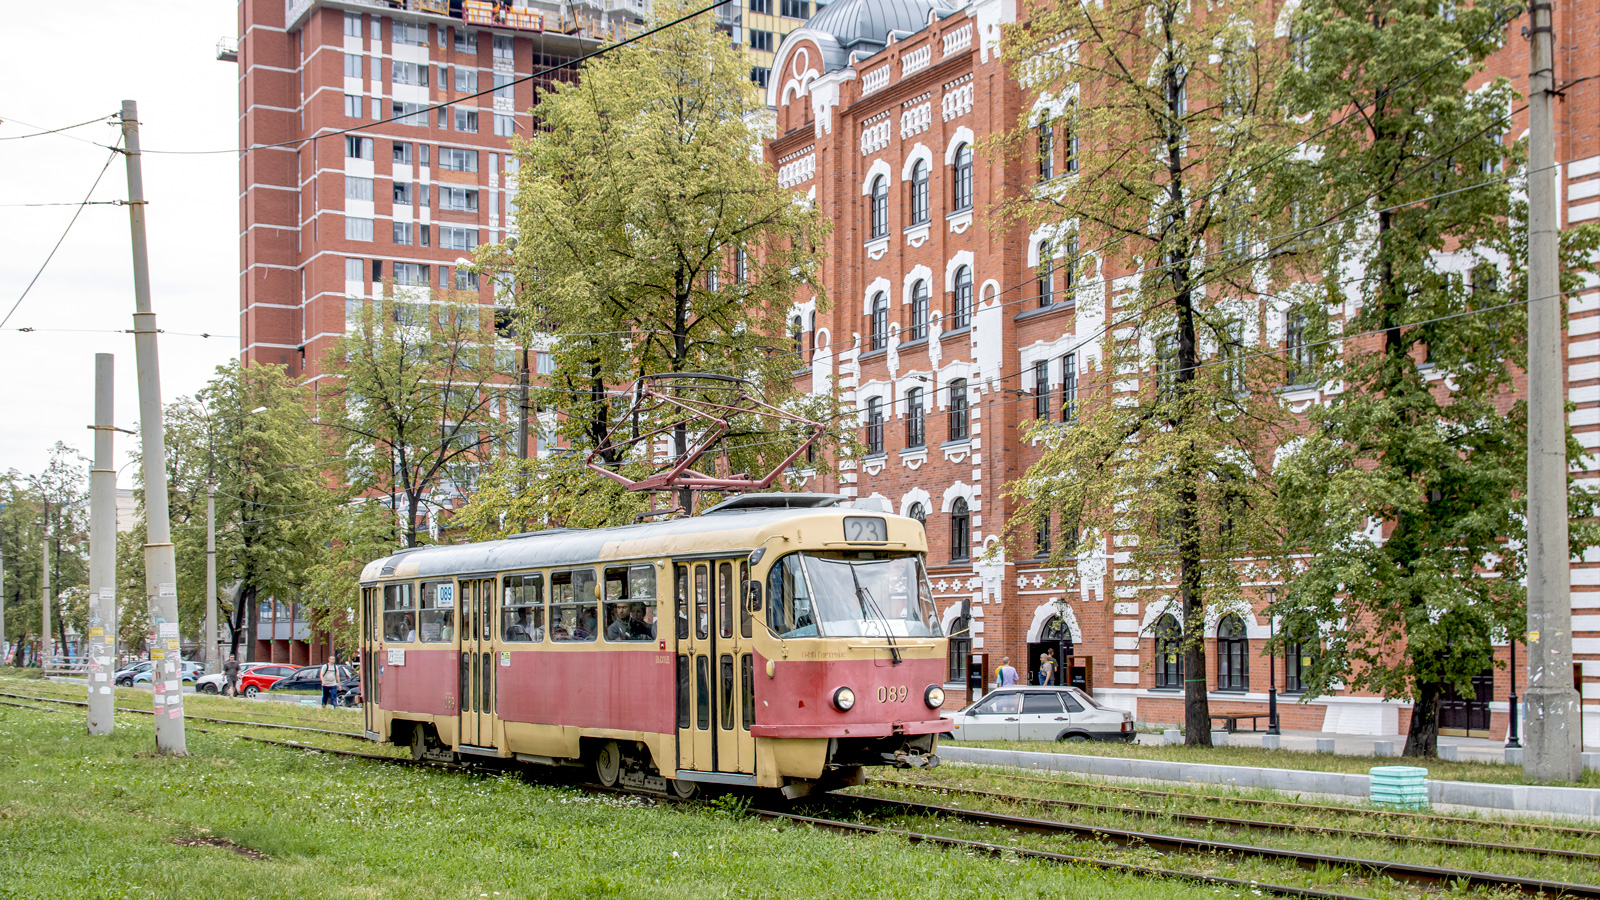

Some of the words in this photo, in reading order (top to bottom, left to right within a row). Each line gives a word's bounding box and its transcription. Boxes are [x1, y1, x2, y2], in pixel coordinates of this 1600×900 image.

[851, 521, 879, 542] 23
[440, 586, 452, 601] 089
[861, 620, 881, 636] 23
[877, 685, 909, 704] 089
